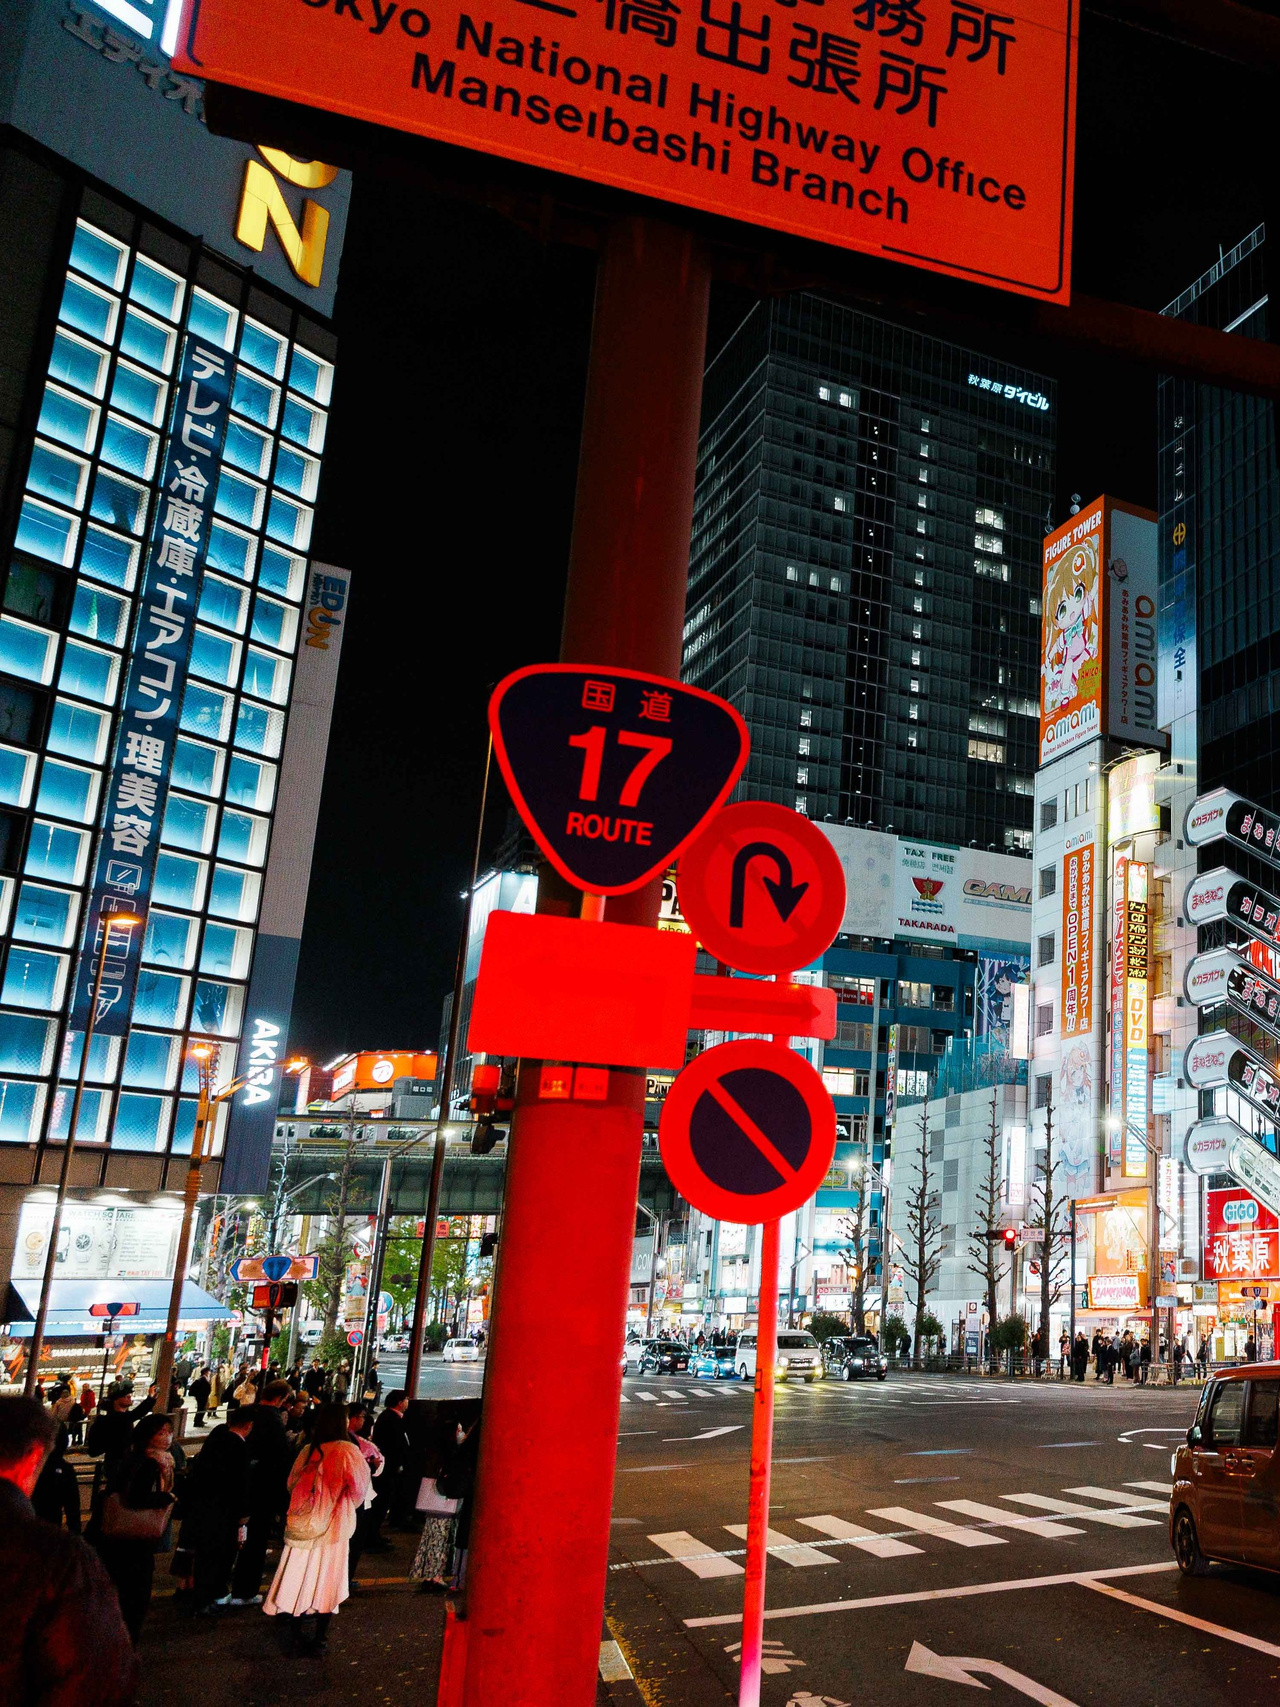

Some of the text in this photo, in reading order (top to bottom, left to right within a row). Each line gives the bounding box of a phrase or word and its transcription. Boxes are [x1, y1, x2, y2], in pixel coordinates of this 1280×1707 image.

[61, 2, 206, 123] エディオ
[456, 13, 669, 108] National
[689, 82, 881, 174] Highway
[902, 147, 1027, 210] Office
[411, 52, 910, 224] Manseibashi Branch
[967, 373, 1050, 411] 秋葉原ダイビル
[1044, 510, 1102, 564] FIGURE TOWER
[1135, 594, 1156, 731] amiami
[582, 680, 674, 723] 国道
[1046, 701, 1096, 743] amiami
[568, 724, 674, 808] 17
[566, 811, 654, 846] ROUTE
[1195, 808, 1220, 829] カラオケ
[1065, 829, 1094, 849] amiami
[904, 847, 955, 863] TAX FREE
[963, 879, 1032, 905] GAM
[1192, 887, 1225, 910] まねきねこ
[1129, 902, 1146, 912] ゲーム
[1131, 913, 1145, 923] CD
[898, 917, 955, 934] TAKARADA
[1128, 935, 1147, 945] アニメ
[1128, 946, 1146, 956] コミック
[1129, 957, 1146, 966] ホビー
[1196, 969, 1220, 985] カラオケ
[1130, 997, 1144, 1043] DVD
[1192, 1050, 1225, 1073] まねきねこ
[1197, 1138, 1222, 1152] カラオケ
[1224, 1202, 1257, 1222] GiGO
[1213, 1237, 1271, 1273] 秋葉原
